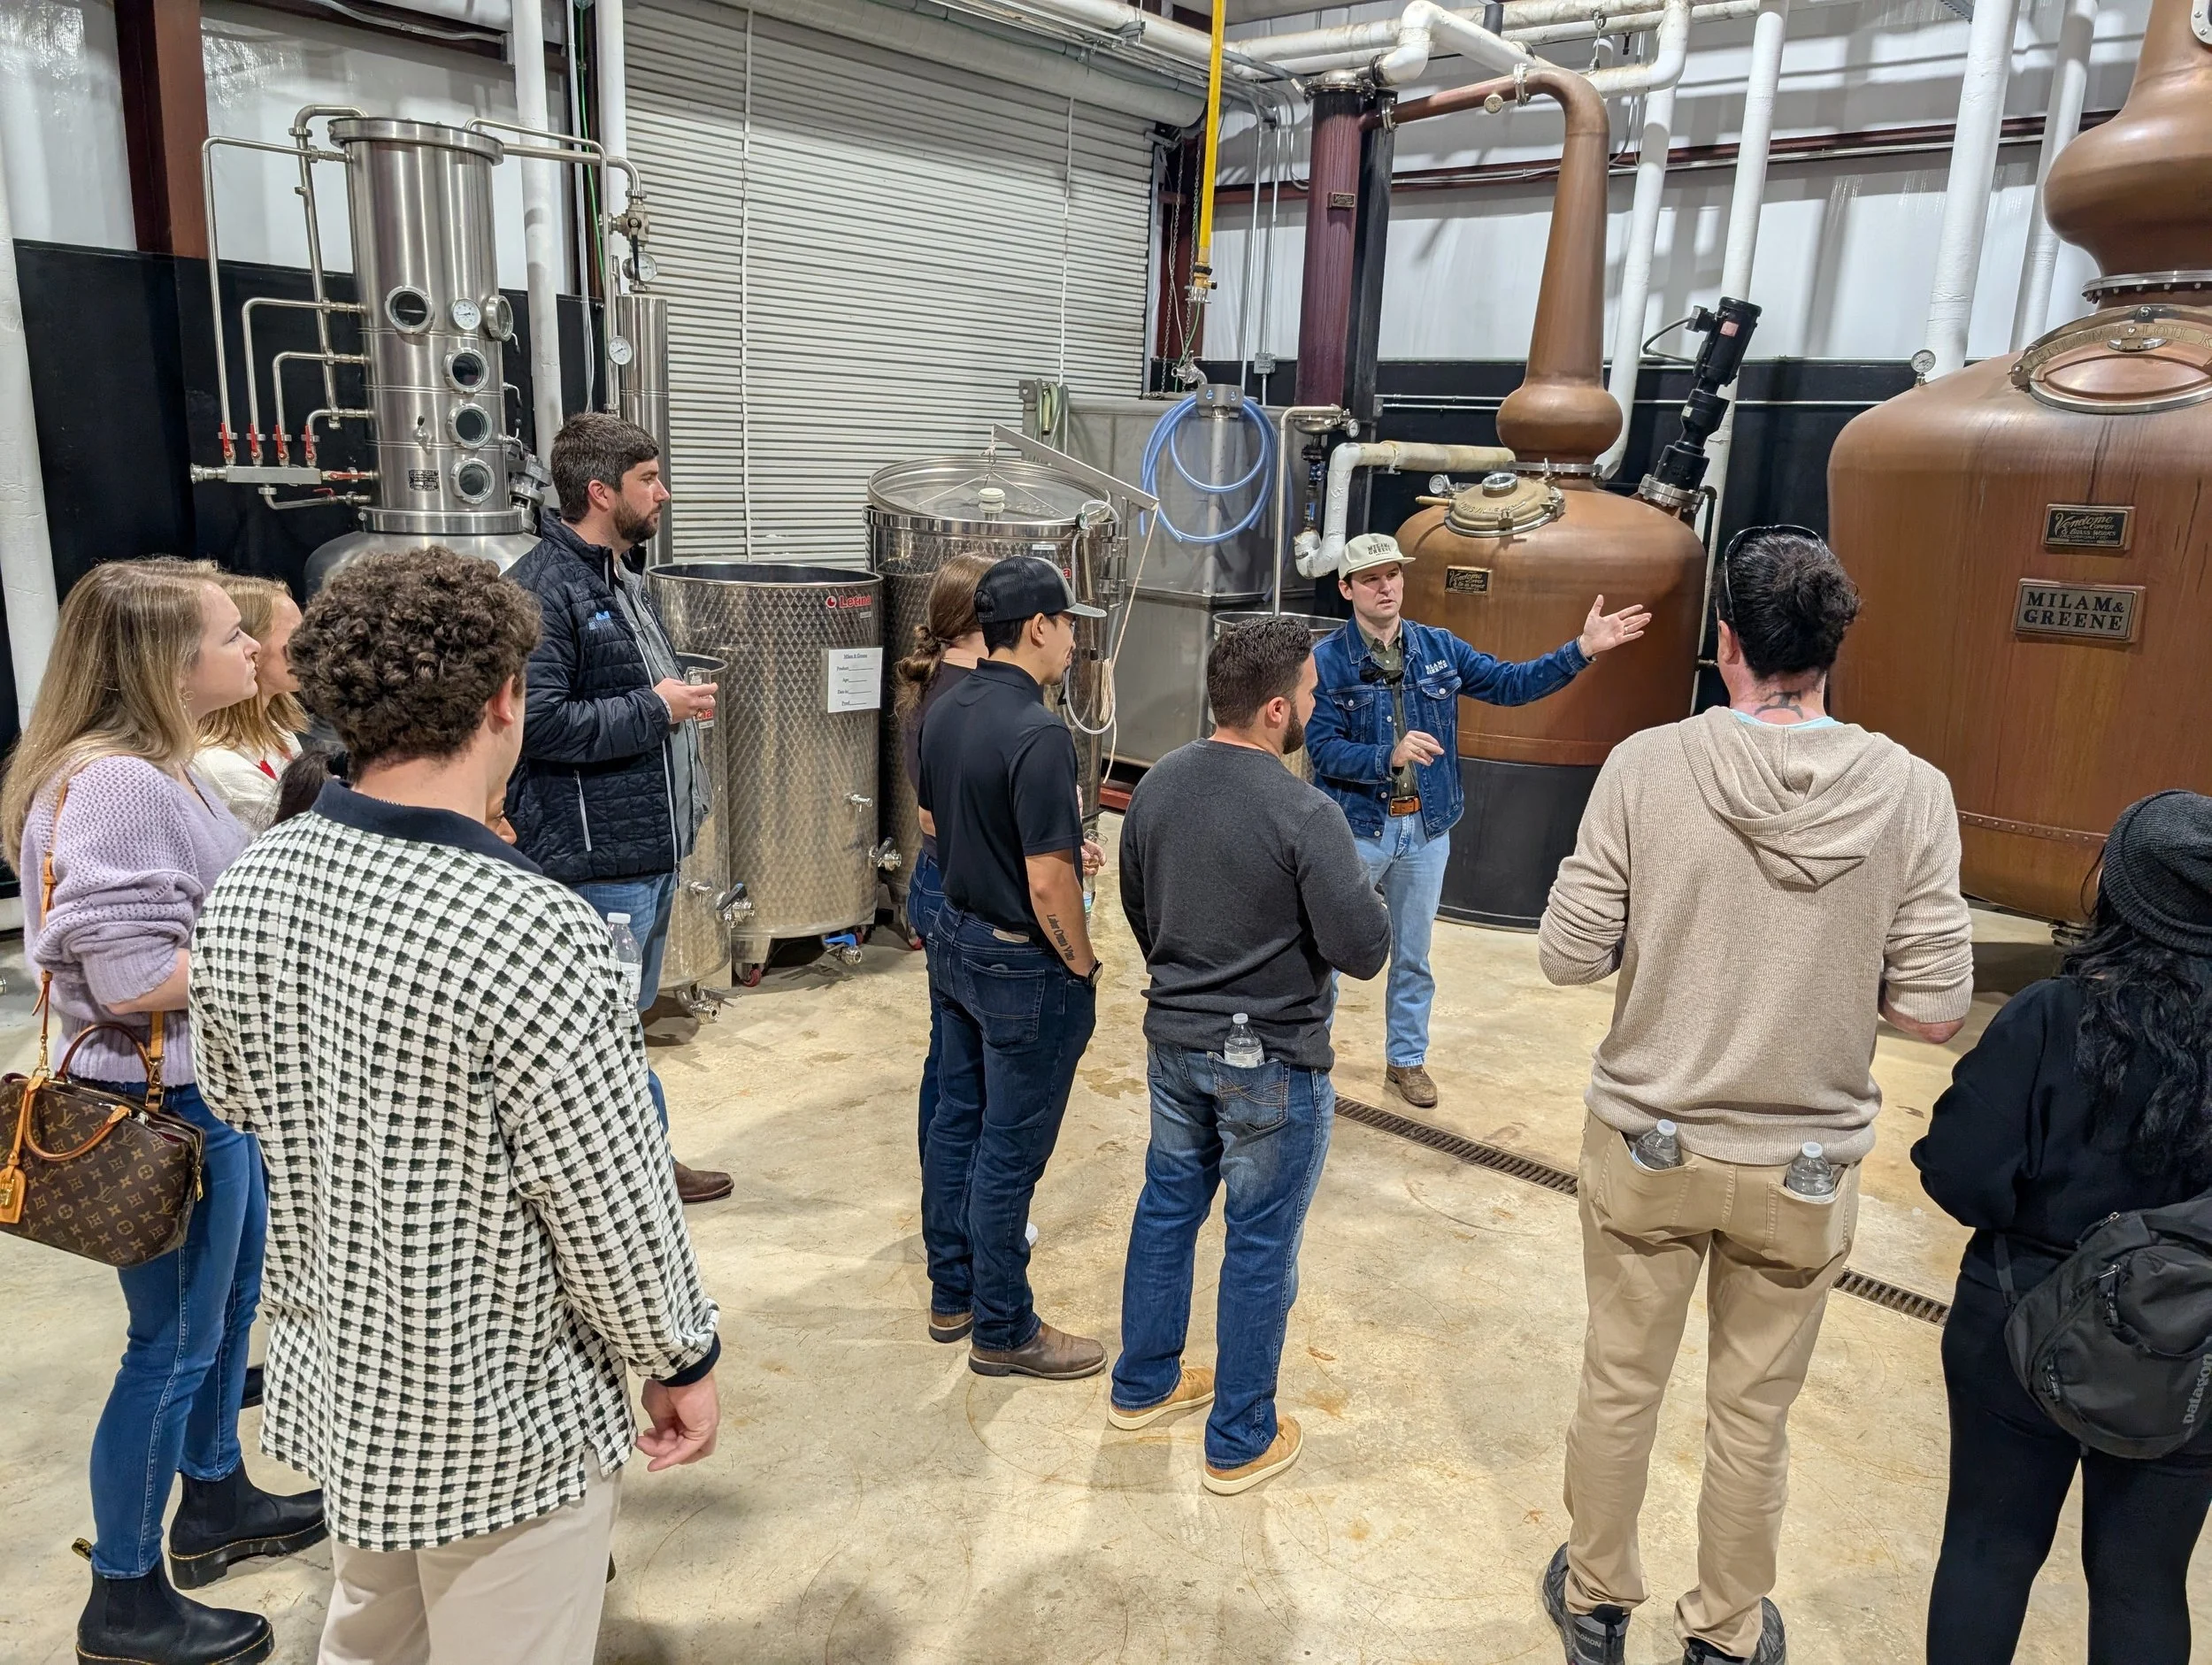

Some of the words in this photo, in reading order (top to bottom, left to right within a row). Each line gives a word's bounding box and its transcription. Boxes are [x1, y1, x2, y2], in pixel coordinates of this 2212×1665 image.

[2055, 512, 2114, 537] Vendome
[839, 595, 872, 608] Letina
[2025, 591, 2124, 613] MILAM&
[2023, 609, 2124, 631] GREENE
